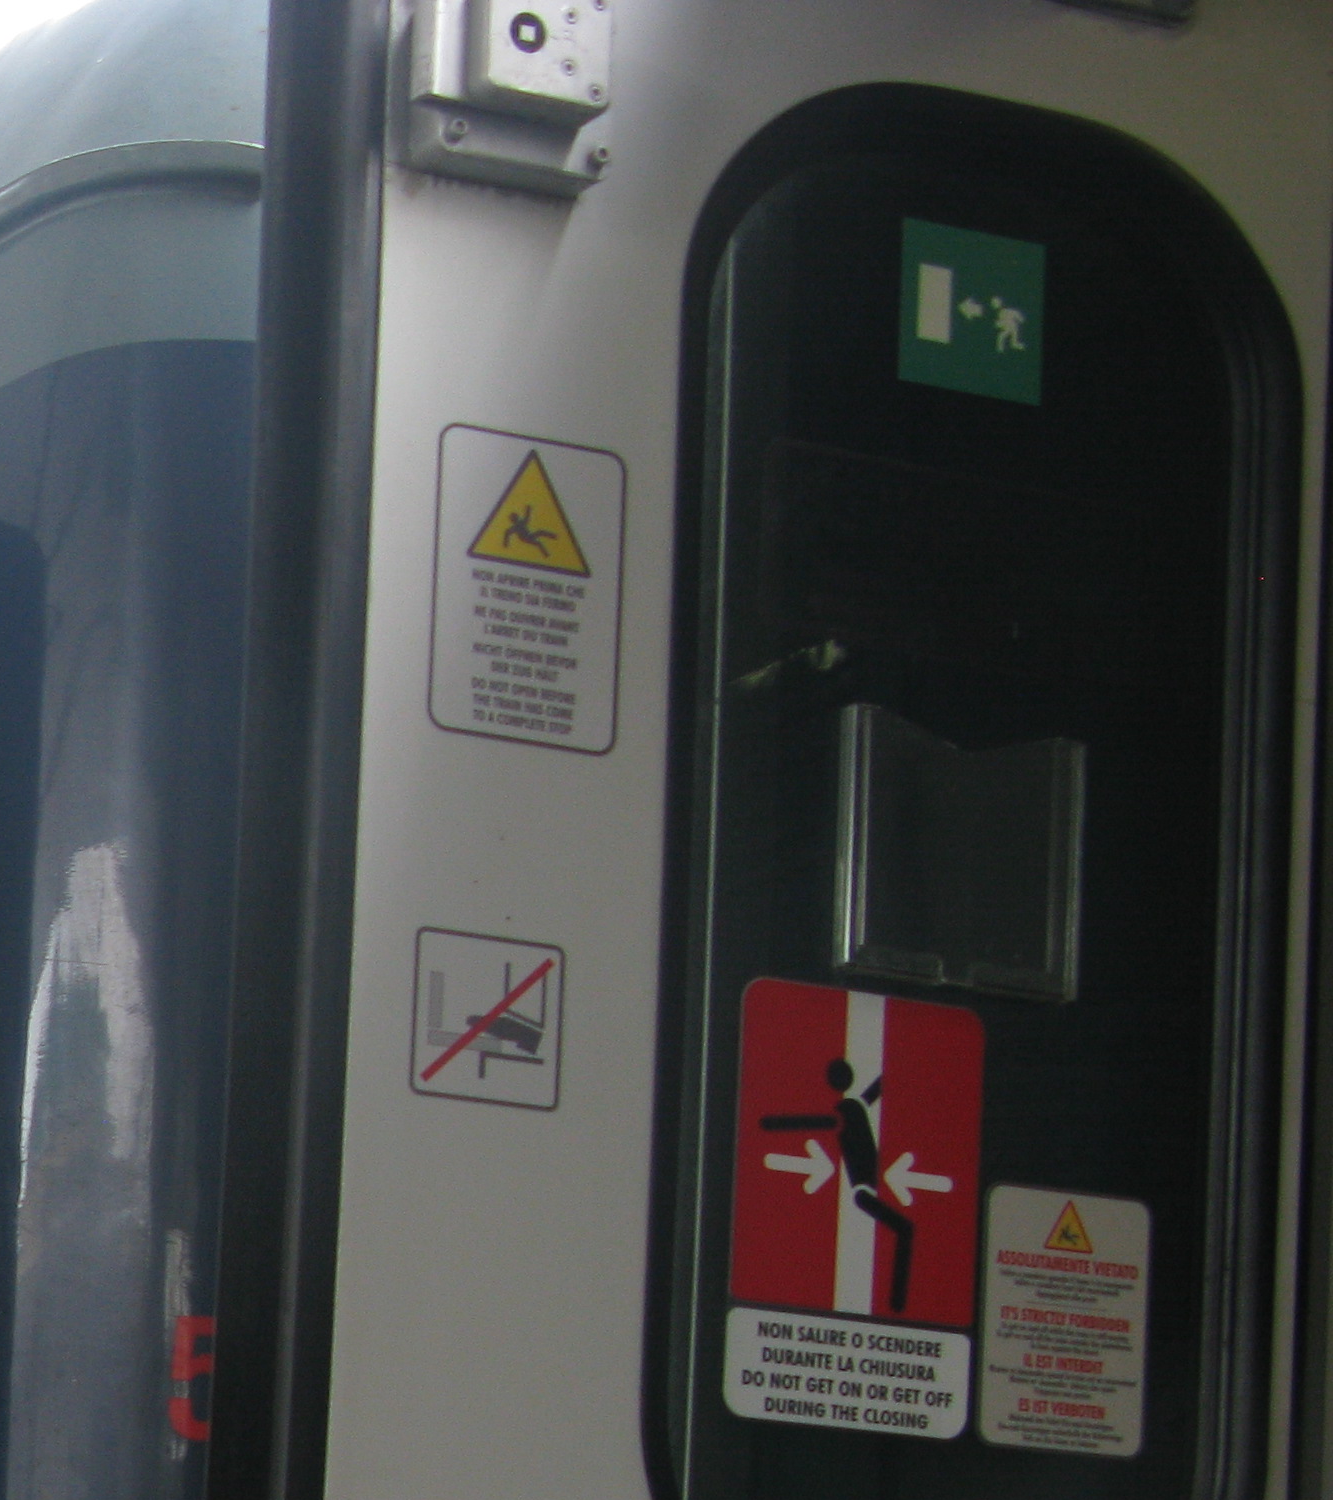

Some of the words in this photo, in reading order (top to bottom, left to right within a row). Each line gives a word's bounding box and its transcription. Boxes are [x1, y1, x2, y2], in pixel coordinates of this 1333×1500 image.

[565, 584, 585, 599] CHE
[471, 676, 487, 690] DO
[489, 680, 509, 693] NOT
[511, 683, 538, 698] OPEN
[474, 693, 491, 706] THE
[493, 696, 522, 712] TRAIN
[548, 721, 572, 735] STOP
[996, 1249, 1090, 1275] ASSOLUTAMENTE
[1094, 1260, 1138, 1280] VIETATO
[1068, 1312, 1131, 1334] FORBIDDEN
[758, 1320, 793, 1340] NON
[797, 1325, 847, 1347] SALIRE
[851, 1332, 863, 1347] O
[867, 1334, 942, 1358] SCENDERE
[762, 1346, 833, 1371] DURANTE
[837, 1355, 855, 1373] LA
[859, 1358, 935, 1382] CHIUSURA
[741, 1369, 765, 1387] DO
[769, 1372, 801, 1391] NOT
[805, 1377, 835, 1395] GET
[839, 1380, 863, 1398] ON
[866, 1384, 888, 1401] OR
[892, 1387, 923, 1405] GET
[925, 1391, 953, 1409] OFF
[764, 1396, 826, 1418] DURING
[830, 1403, 859, 1422] THE
[863, 1407, 929, 1430] CLOSING
[1051, 1402, 1106, 1420] VERBOTEN
